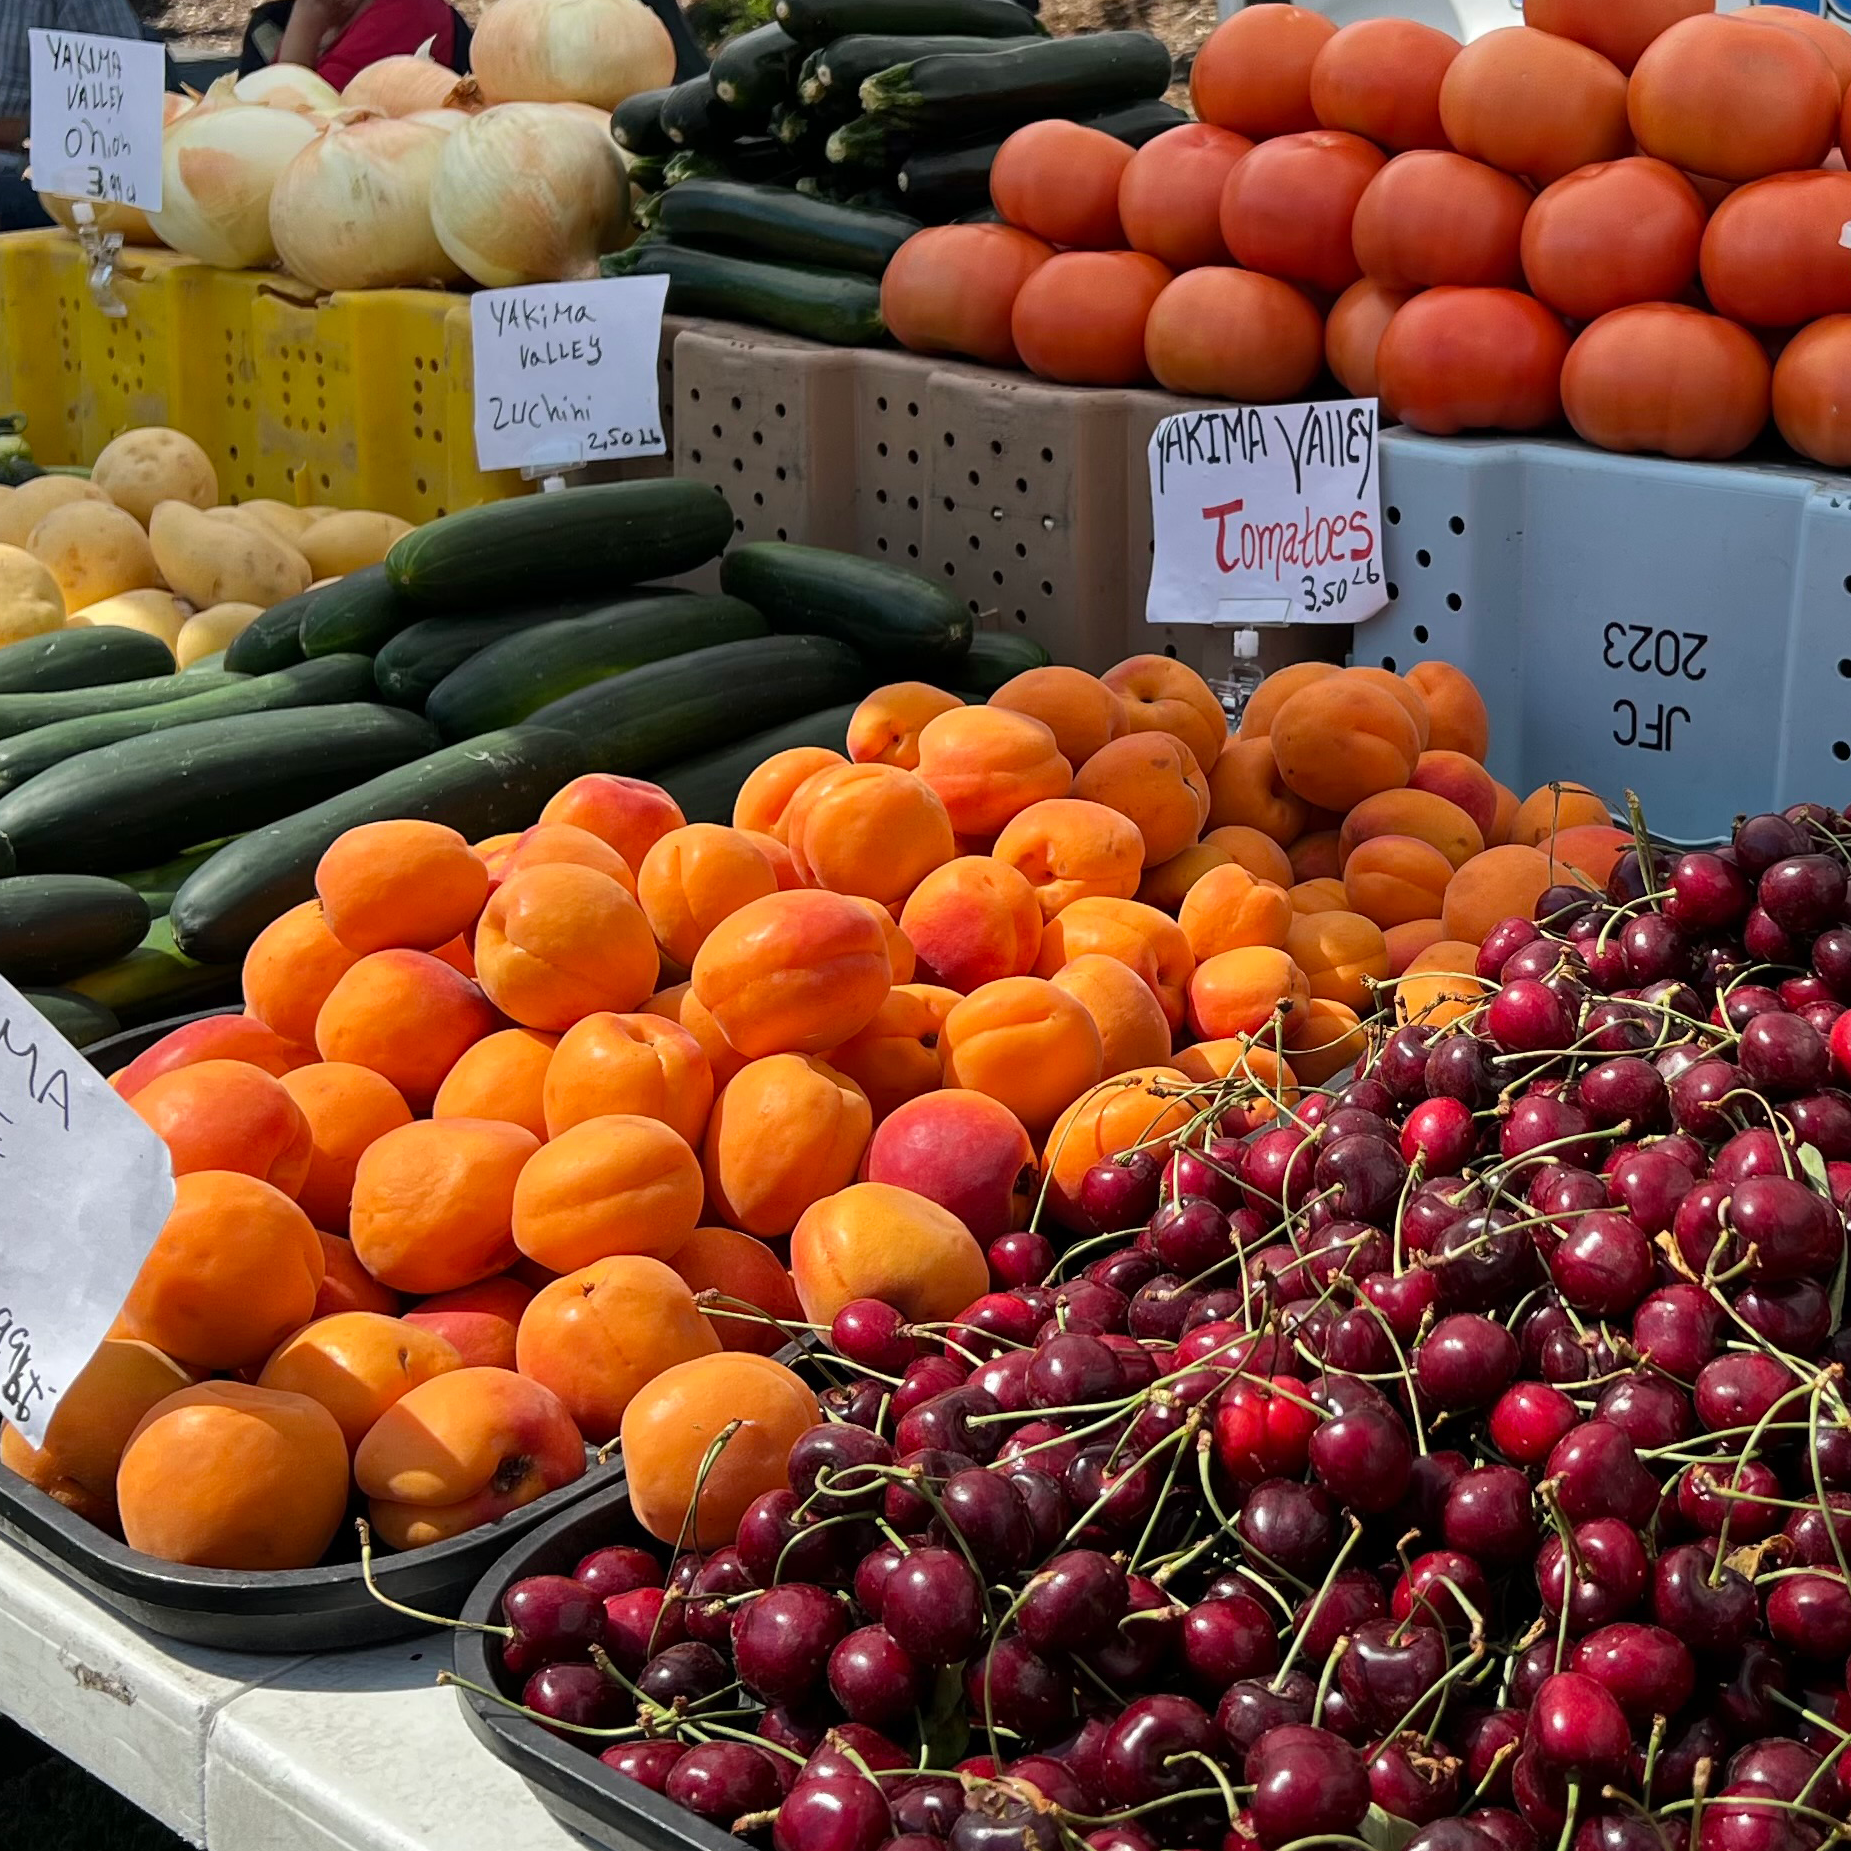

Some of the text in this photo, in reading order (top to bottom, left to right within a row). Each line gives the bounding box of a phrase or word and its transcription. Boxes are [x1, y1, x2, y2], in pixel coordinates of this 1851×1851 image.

[46, 34, 122, 80] YAKIMA
[67, 82, 124, 114] VALLEY
[1156, 406, 1269, 495] YAKIMA
[1202, 498, 1375, 582] Tomatoes
[1603, 621, 1709, 681] 2023
[1612, 698, 1692, 752] JFC
